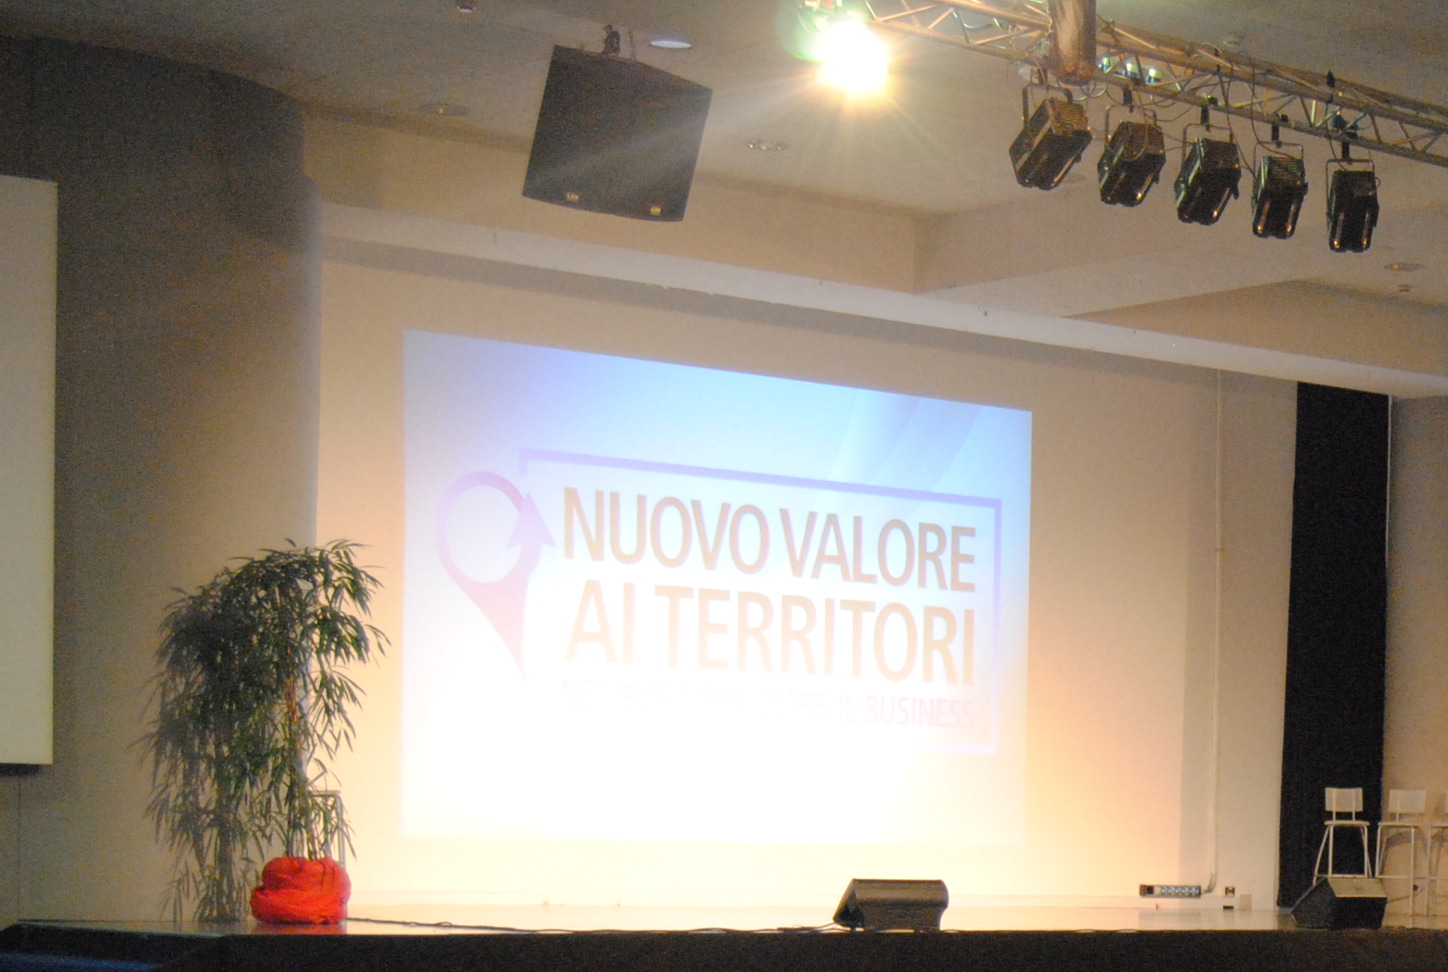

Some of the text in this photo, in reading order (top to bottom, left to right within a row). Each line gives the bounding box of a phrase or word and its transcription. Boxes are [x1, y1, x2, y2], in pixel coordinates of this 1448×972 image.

[562, 486, 977, 593] NUOVO VALORE
[563, 577, 976, 687] AI TERRITORI
[864, 694, 976, 729] BUSINESS
